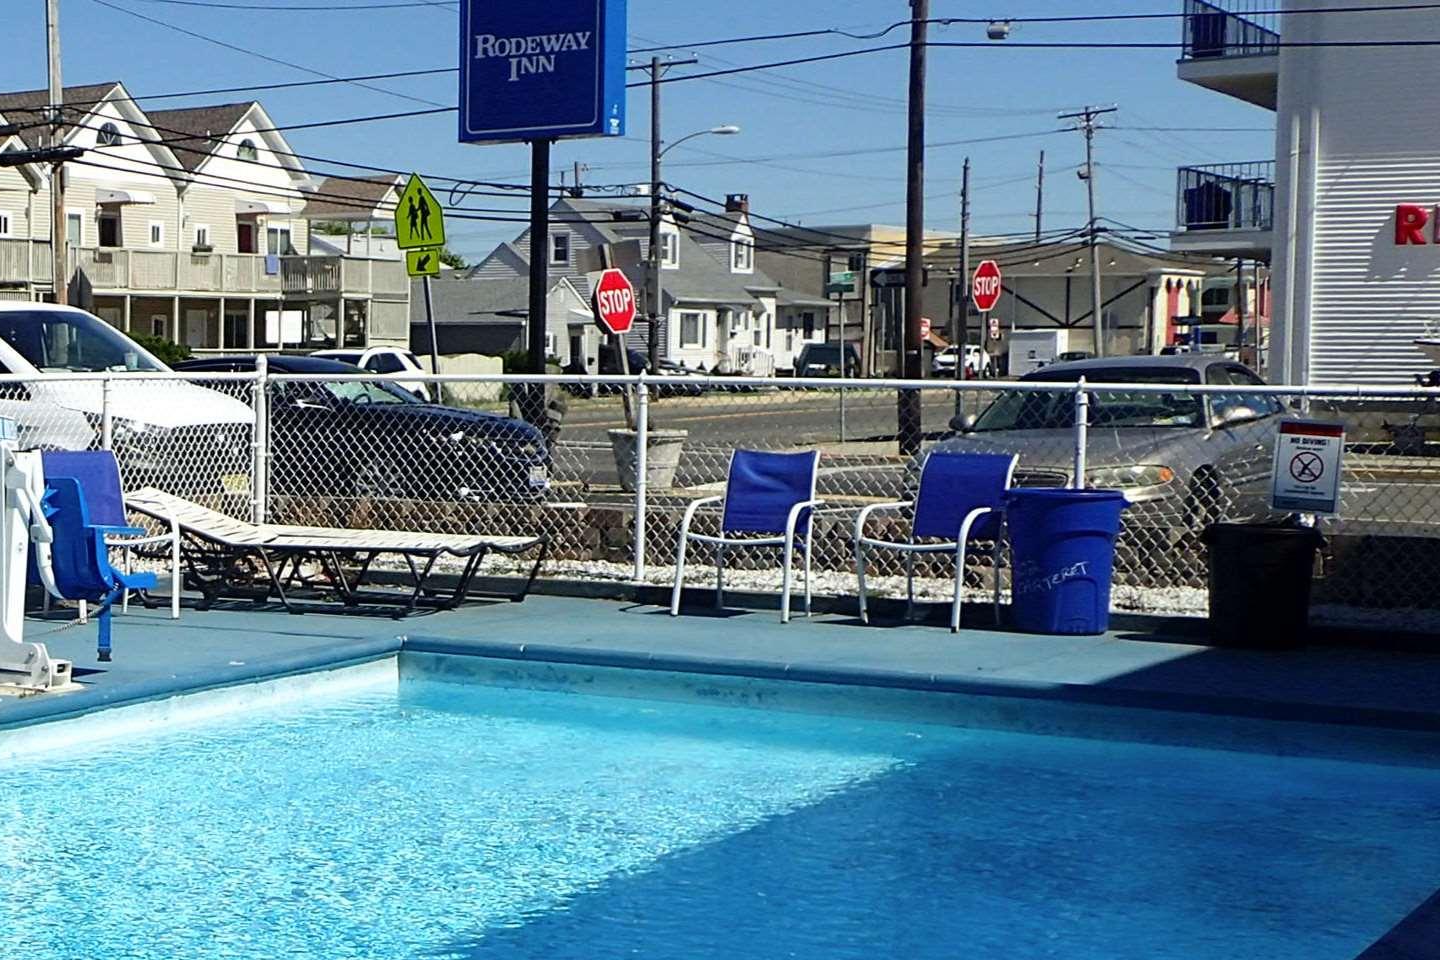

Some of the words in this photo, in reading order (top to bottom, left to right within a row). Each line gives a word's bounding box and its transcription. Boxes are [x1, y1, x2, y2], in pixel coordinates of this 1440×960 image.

[474, 31, 592, 59] RODEWAY
[508, 54, 556, 82] INN
[974, 276, 998, 296] STOP
[600, 288, 631, 315] STOP
